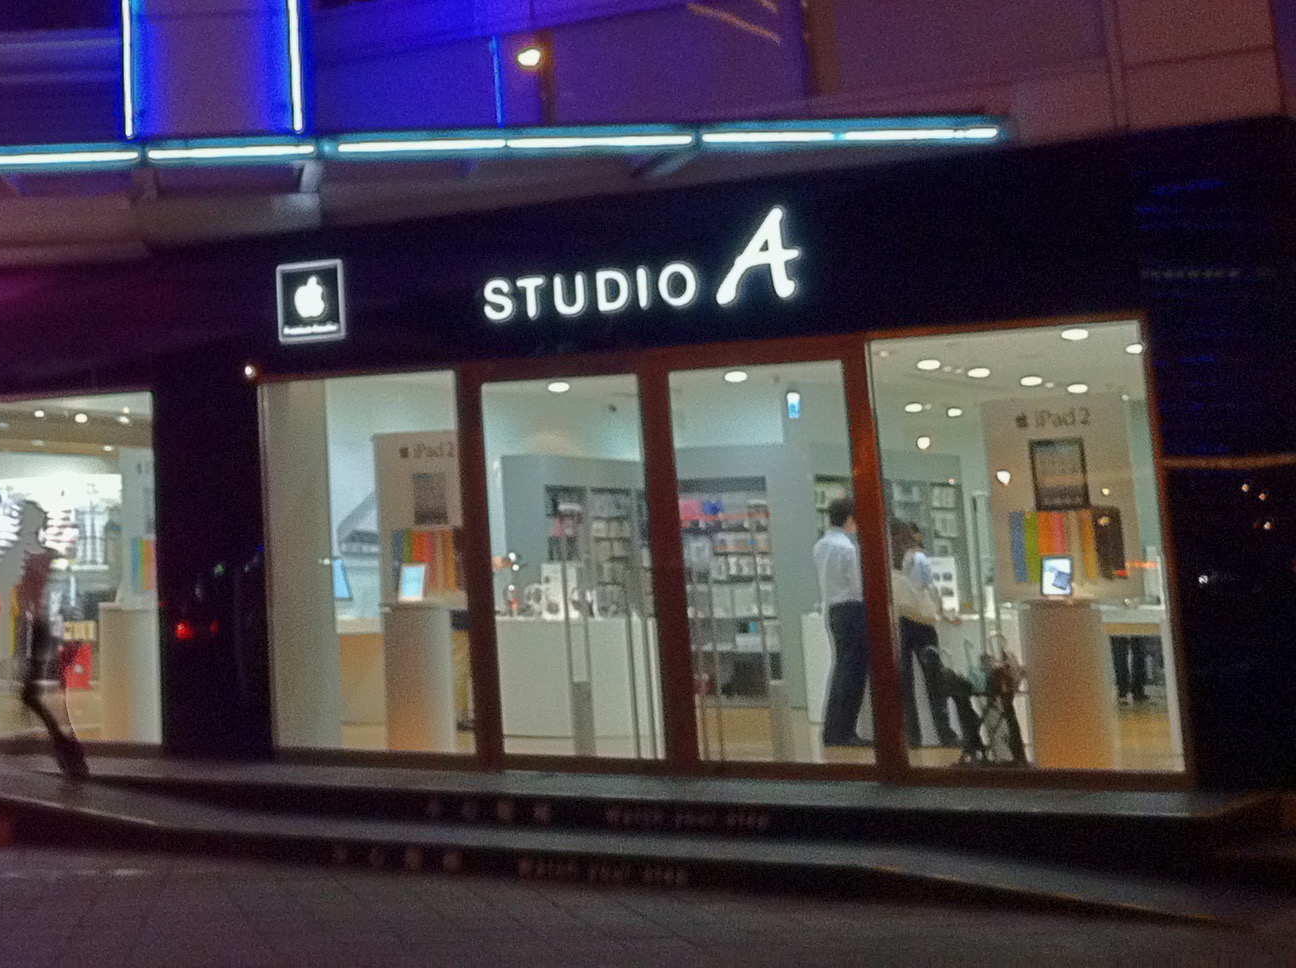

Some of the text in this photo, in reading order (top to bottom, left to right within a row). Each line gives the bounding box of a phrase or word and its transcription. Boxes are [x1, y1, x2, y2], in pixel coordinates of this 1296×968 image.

[482, 205, 801, 322] STUDIO A
[1077, 405, 1091, 426] 2
